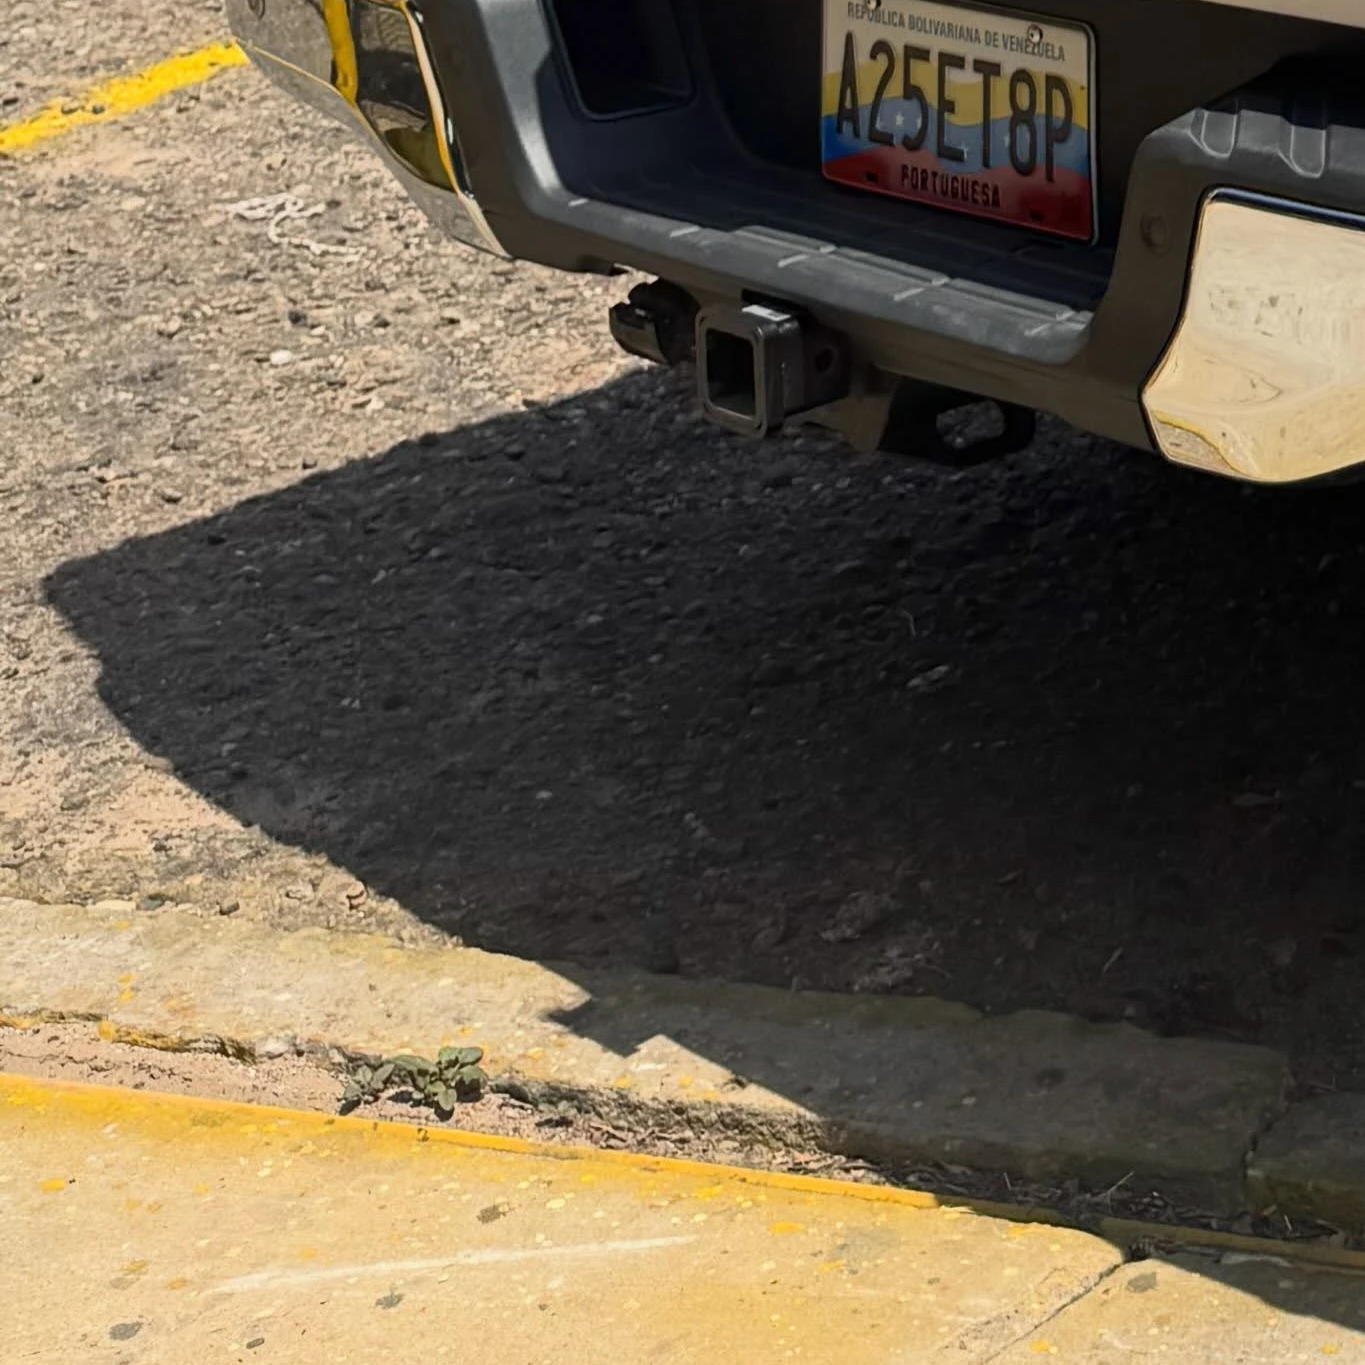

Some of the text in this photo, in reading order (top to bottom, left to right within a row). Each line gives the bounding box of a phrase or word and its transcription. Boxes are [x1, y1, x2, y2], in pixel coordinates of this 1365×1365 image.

[907, 18, 982, 45] BOLIVARIANA
[984, 29, 999, 49] DE
[1001, 33, 1066, 62] VENEZUELA
[835, 29, 1073, 183] A25ET8P
[901, 163, 1001, 208] PORTUGUESA
